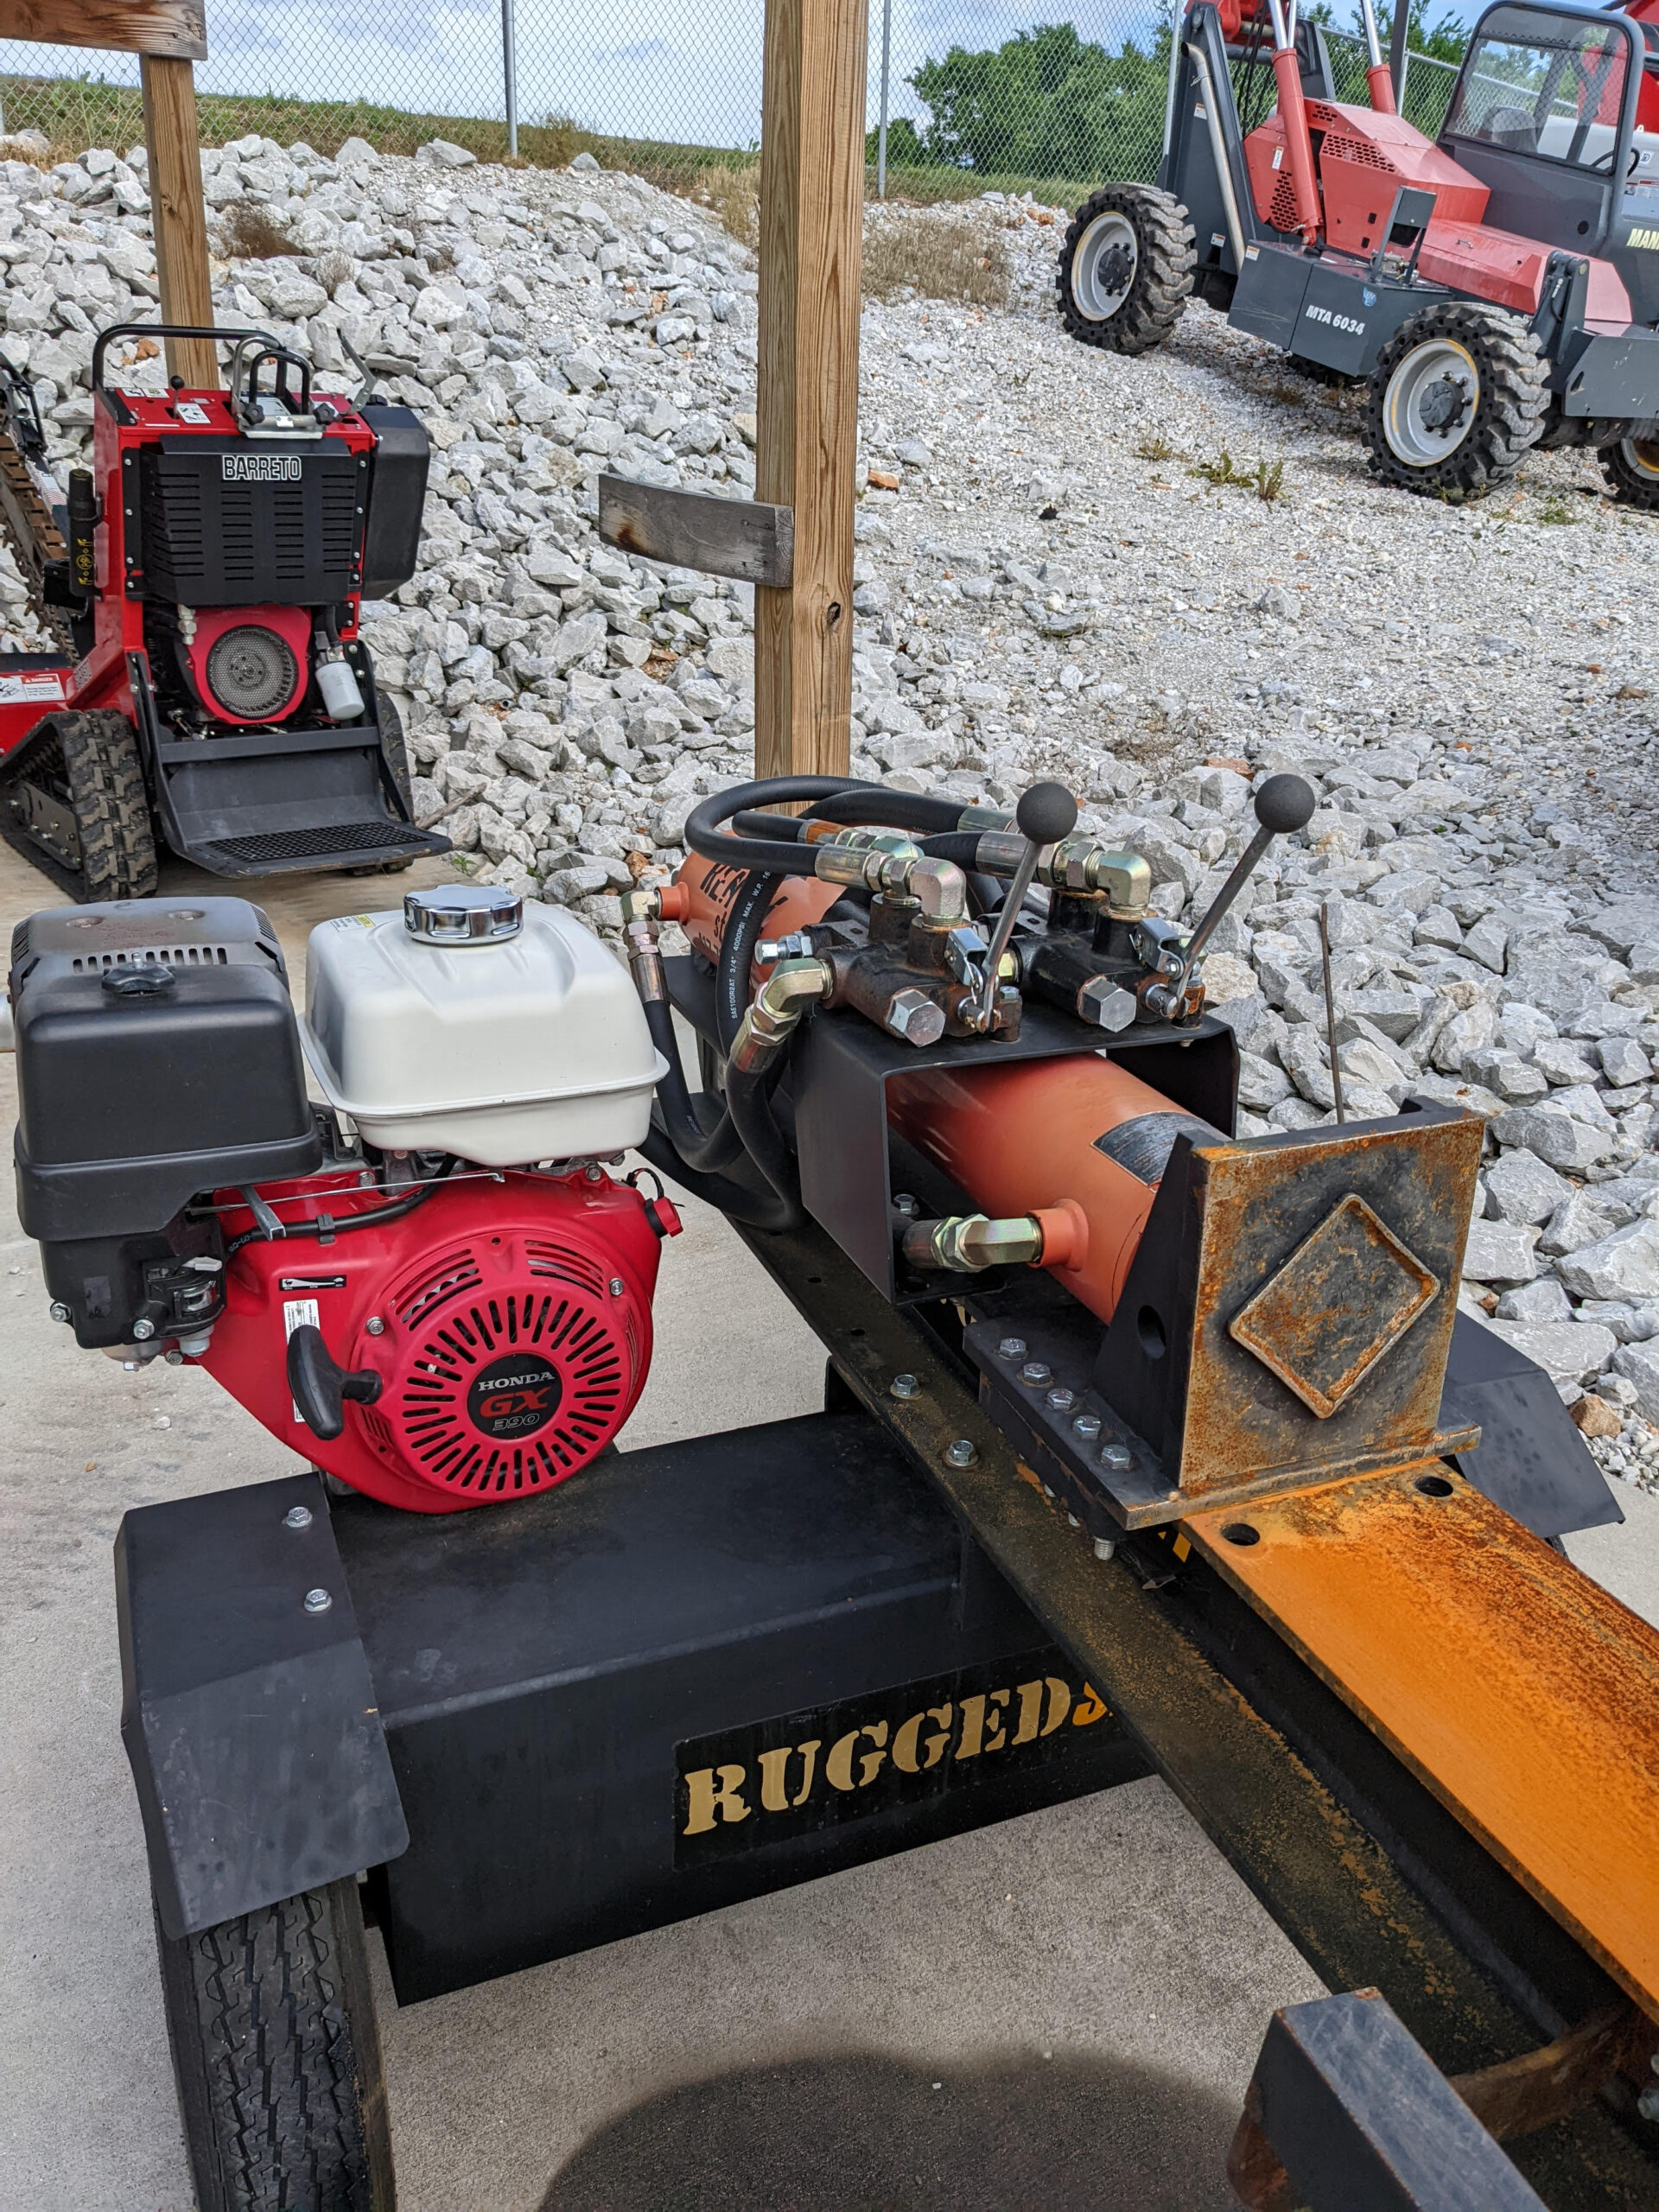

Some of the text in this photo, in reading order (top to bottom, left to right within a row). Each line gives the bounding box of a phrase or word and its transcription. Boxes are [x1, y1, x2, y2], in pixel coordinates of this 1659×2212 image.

[1306, 304, 1365, 335] MTA 6034
[222, 455, 302, 480] BARRETO
[729, 979, 738, 1019] SAE100R2AT
[734, 922, 746, 951] 4000PSI
[743, 901, 754, 918] MAX.
[479, 1371, 556, 1391] HONDA
[480, 1386, 552, 1417] GX
[493, 1413, 540, 1432] 390
